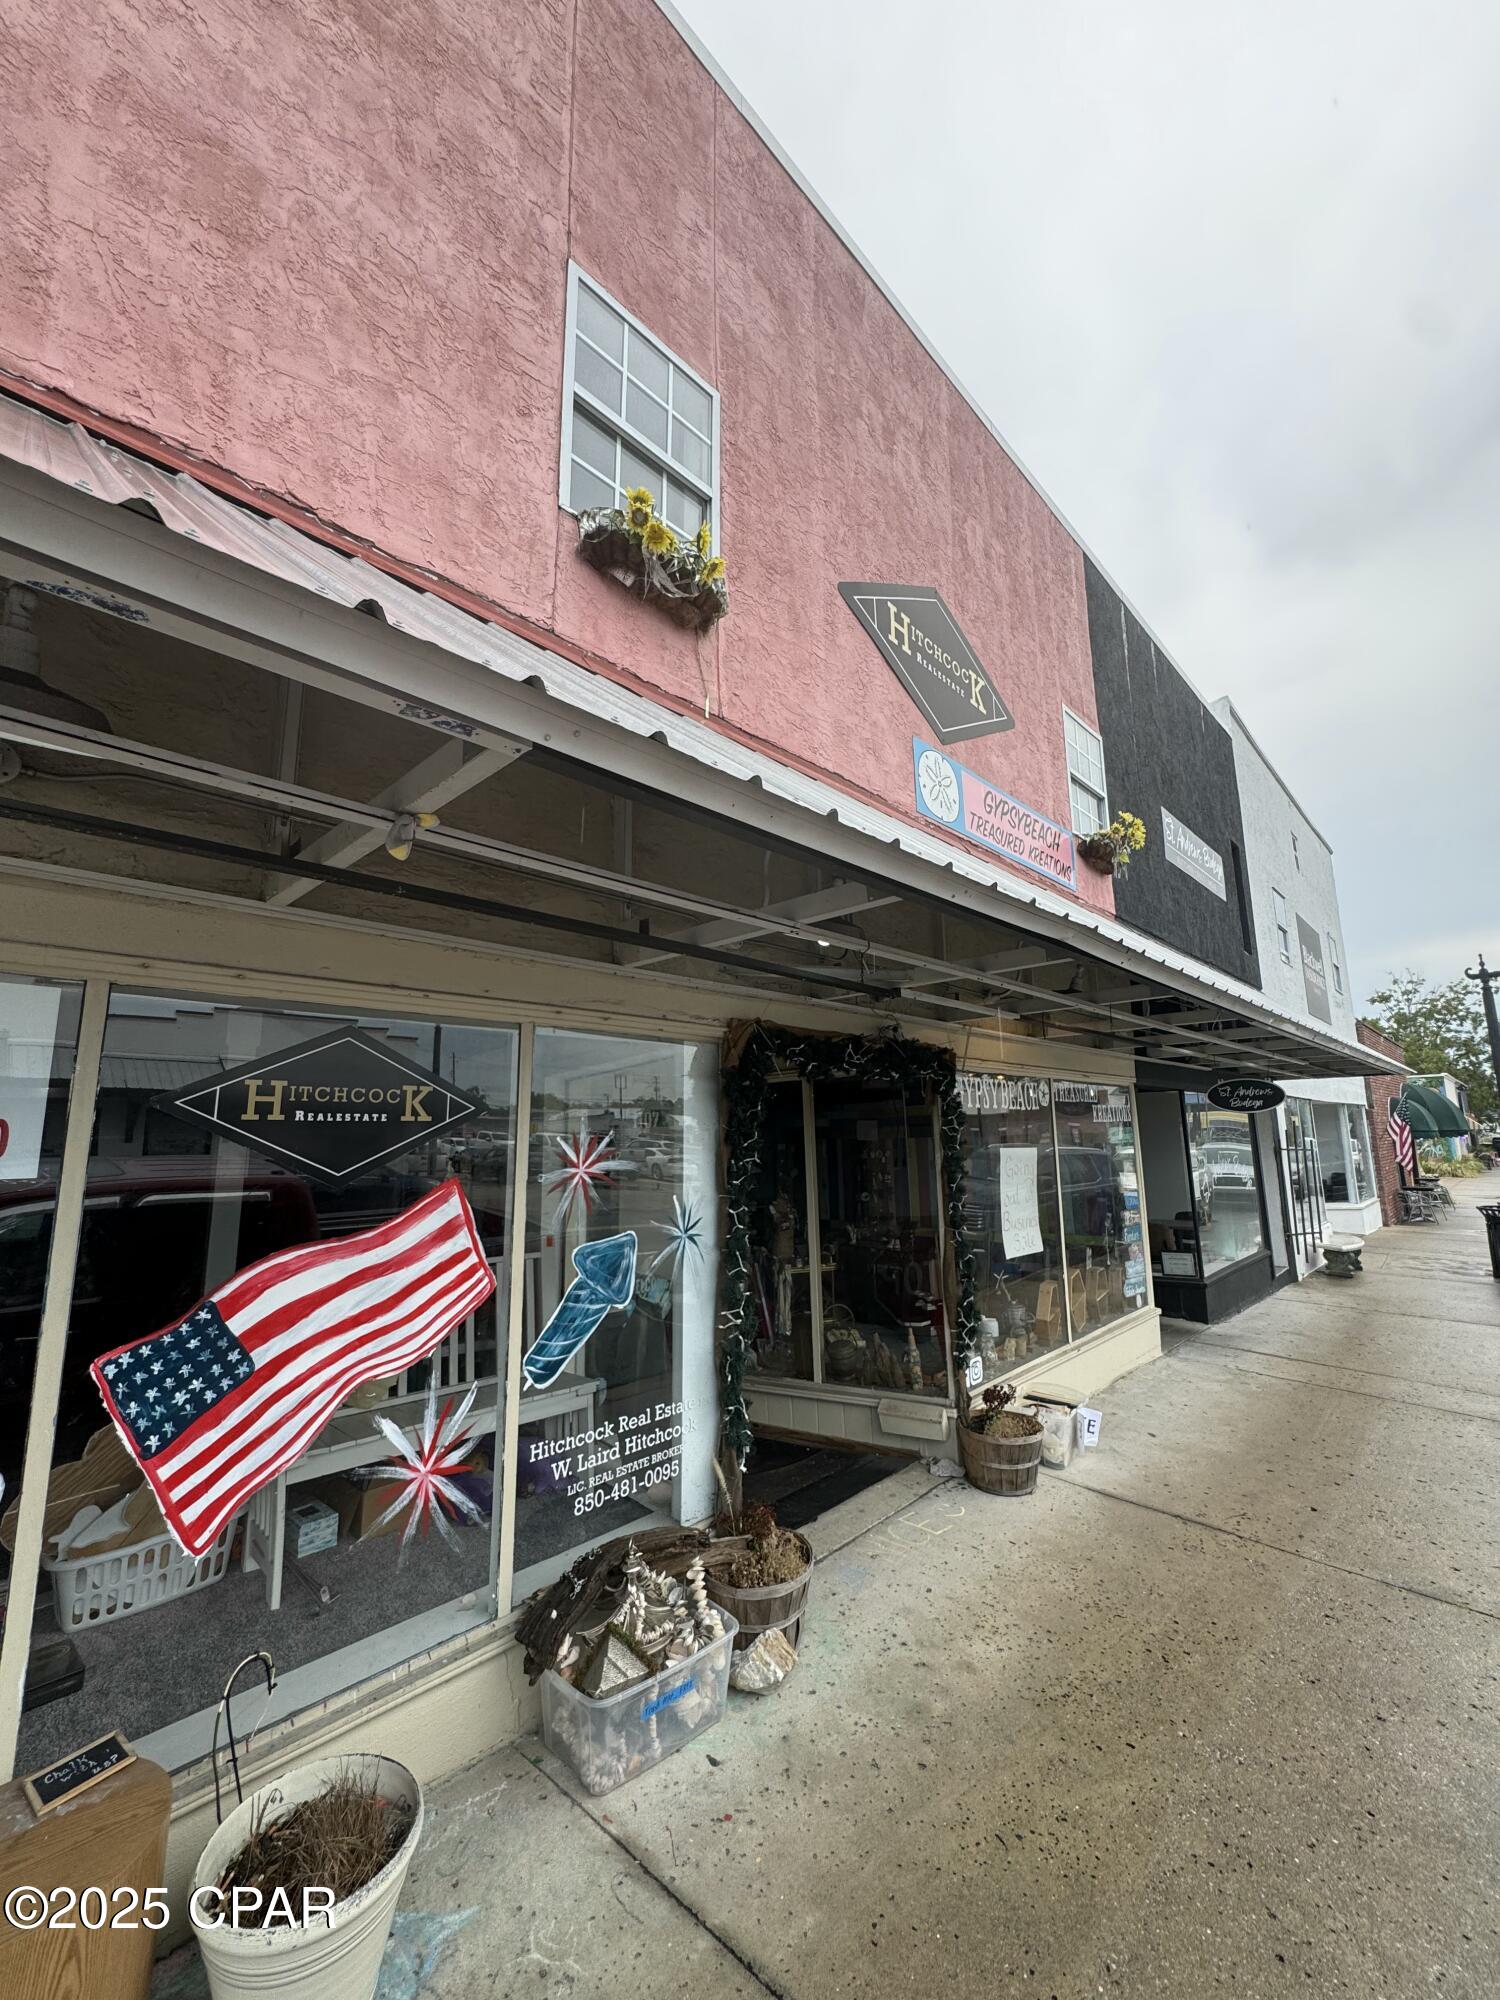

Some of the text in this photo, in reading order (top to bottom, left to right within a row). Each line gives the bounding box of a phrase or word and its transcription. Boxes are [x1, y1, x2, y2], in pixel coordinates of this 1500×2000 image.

[887, 600, 987, 715] HITCHCOCK
[970, 811, 1072, 882] TREASURED KREATIONS
[983, 790, 1061, 853] GYPSYBEACH
[240, 1079, 433, 1122] HITCHCOCK
[294, 1110, 388, 1122] REALESTATE
[529, 1421, 614, 1463] Hitchcock
[618, 1408, 651, 1433] Real
[551, 1458, 573, 1481] W.
[577, 1442, 620, 1472] Laird
[574, 1459, 680, 1516] 850-481-0095
[588, 1471, 614, 1489] REAL
[616, 1456, 650, 1477] ESTATE
